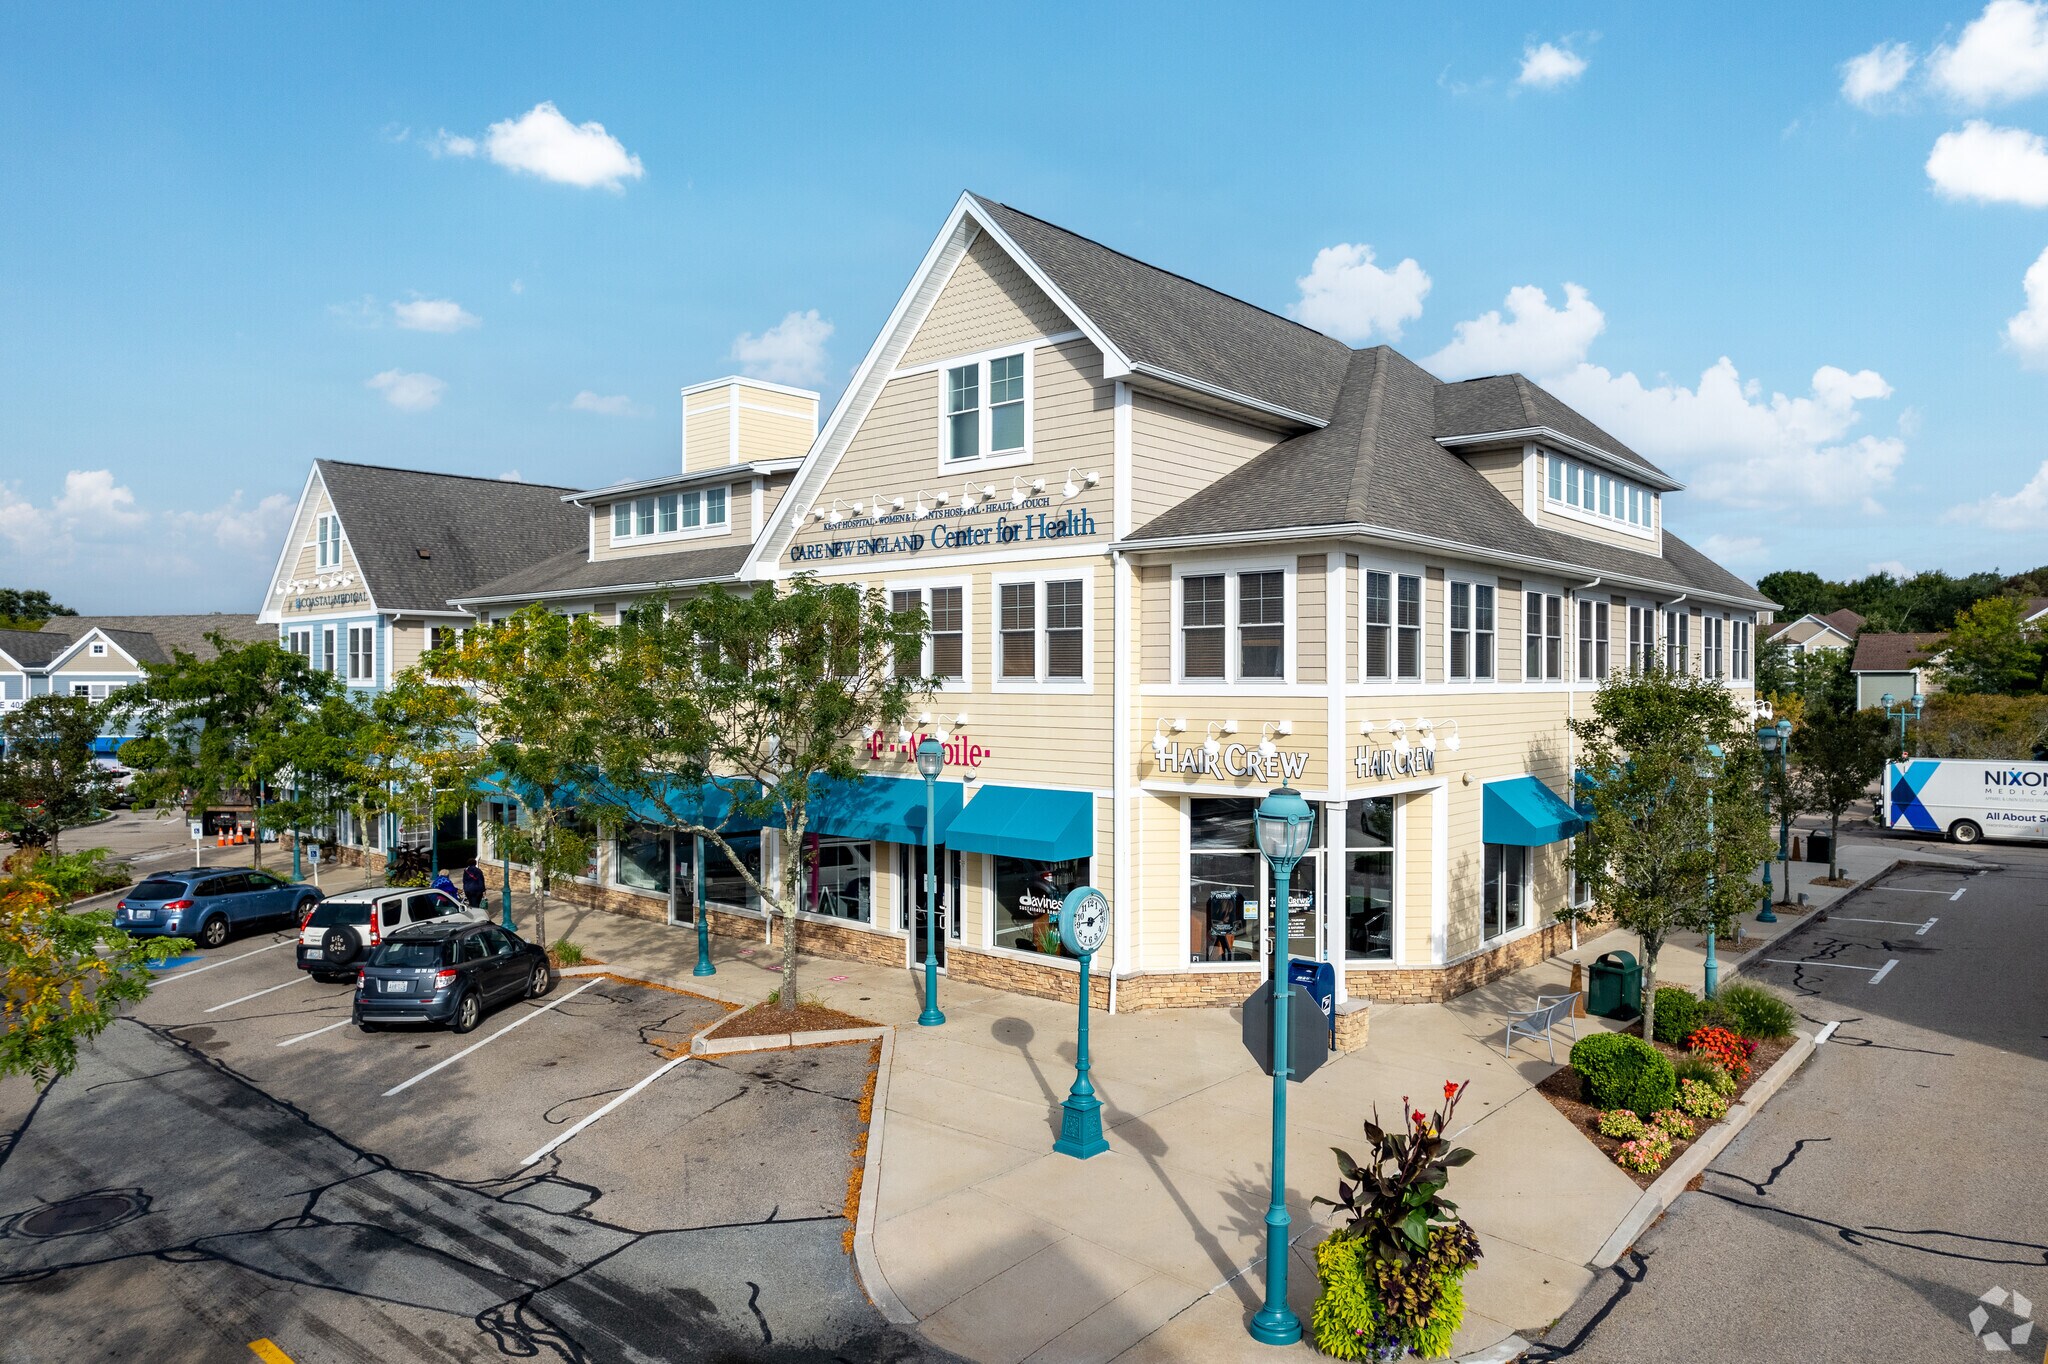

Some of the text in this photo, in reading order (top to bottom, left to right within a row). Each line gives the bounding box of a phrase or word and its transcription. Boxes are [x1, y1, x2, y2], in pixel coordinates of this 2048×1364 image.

[823, 521, 841, 531] KENT
[842, 518, 874, 528] HOSPITAL
[879, 514, 905, 525] WOMEN
[1021, 497, 1050, 508] TOUCH
[790, 507, 1096, 561] CARE NEW ENGLAND Center for Health
[1986, 812, 2048, 823] All About S
